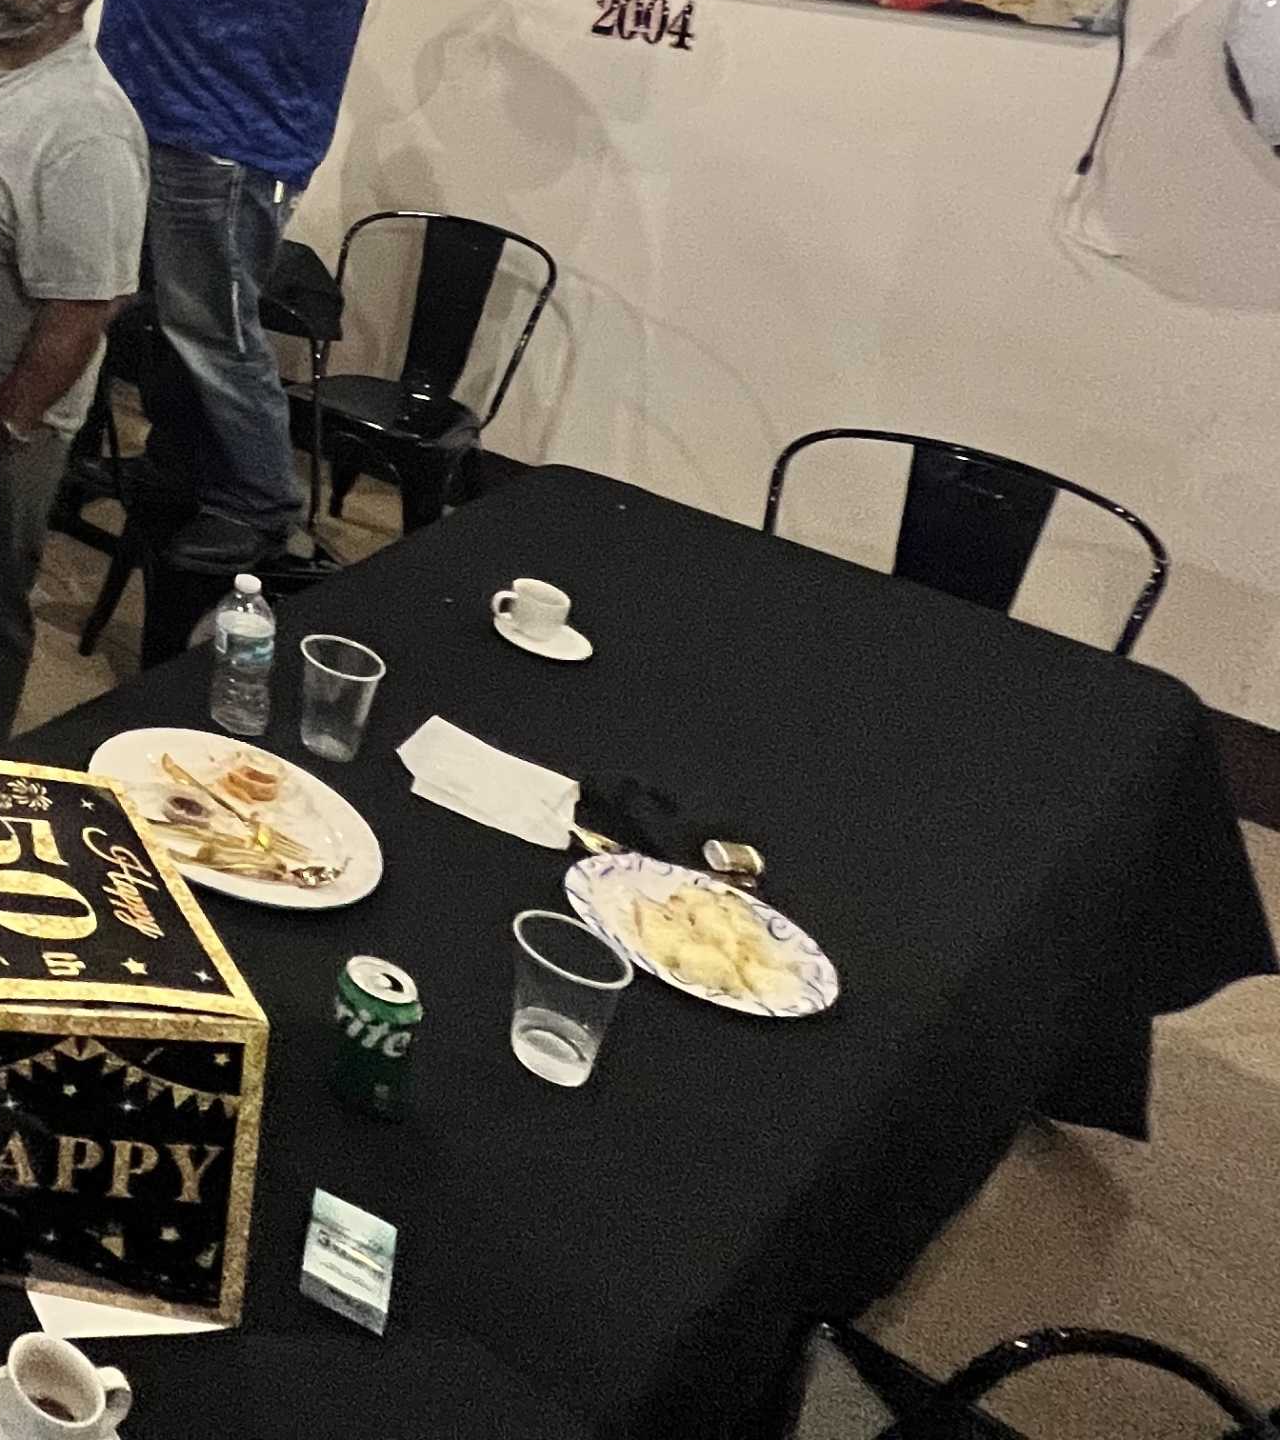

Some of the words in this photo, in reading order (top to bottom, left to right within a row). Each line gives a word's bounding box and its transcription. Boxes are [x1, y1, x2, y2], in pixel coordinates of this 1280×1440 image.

[81, 826, 164, 940] Happy
[41, 951, 88, 978] th
[334, 1000, 413, 1058] rite
